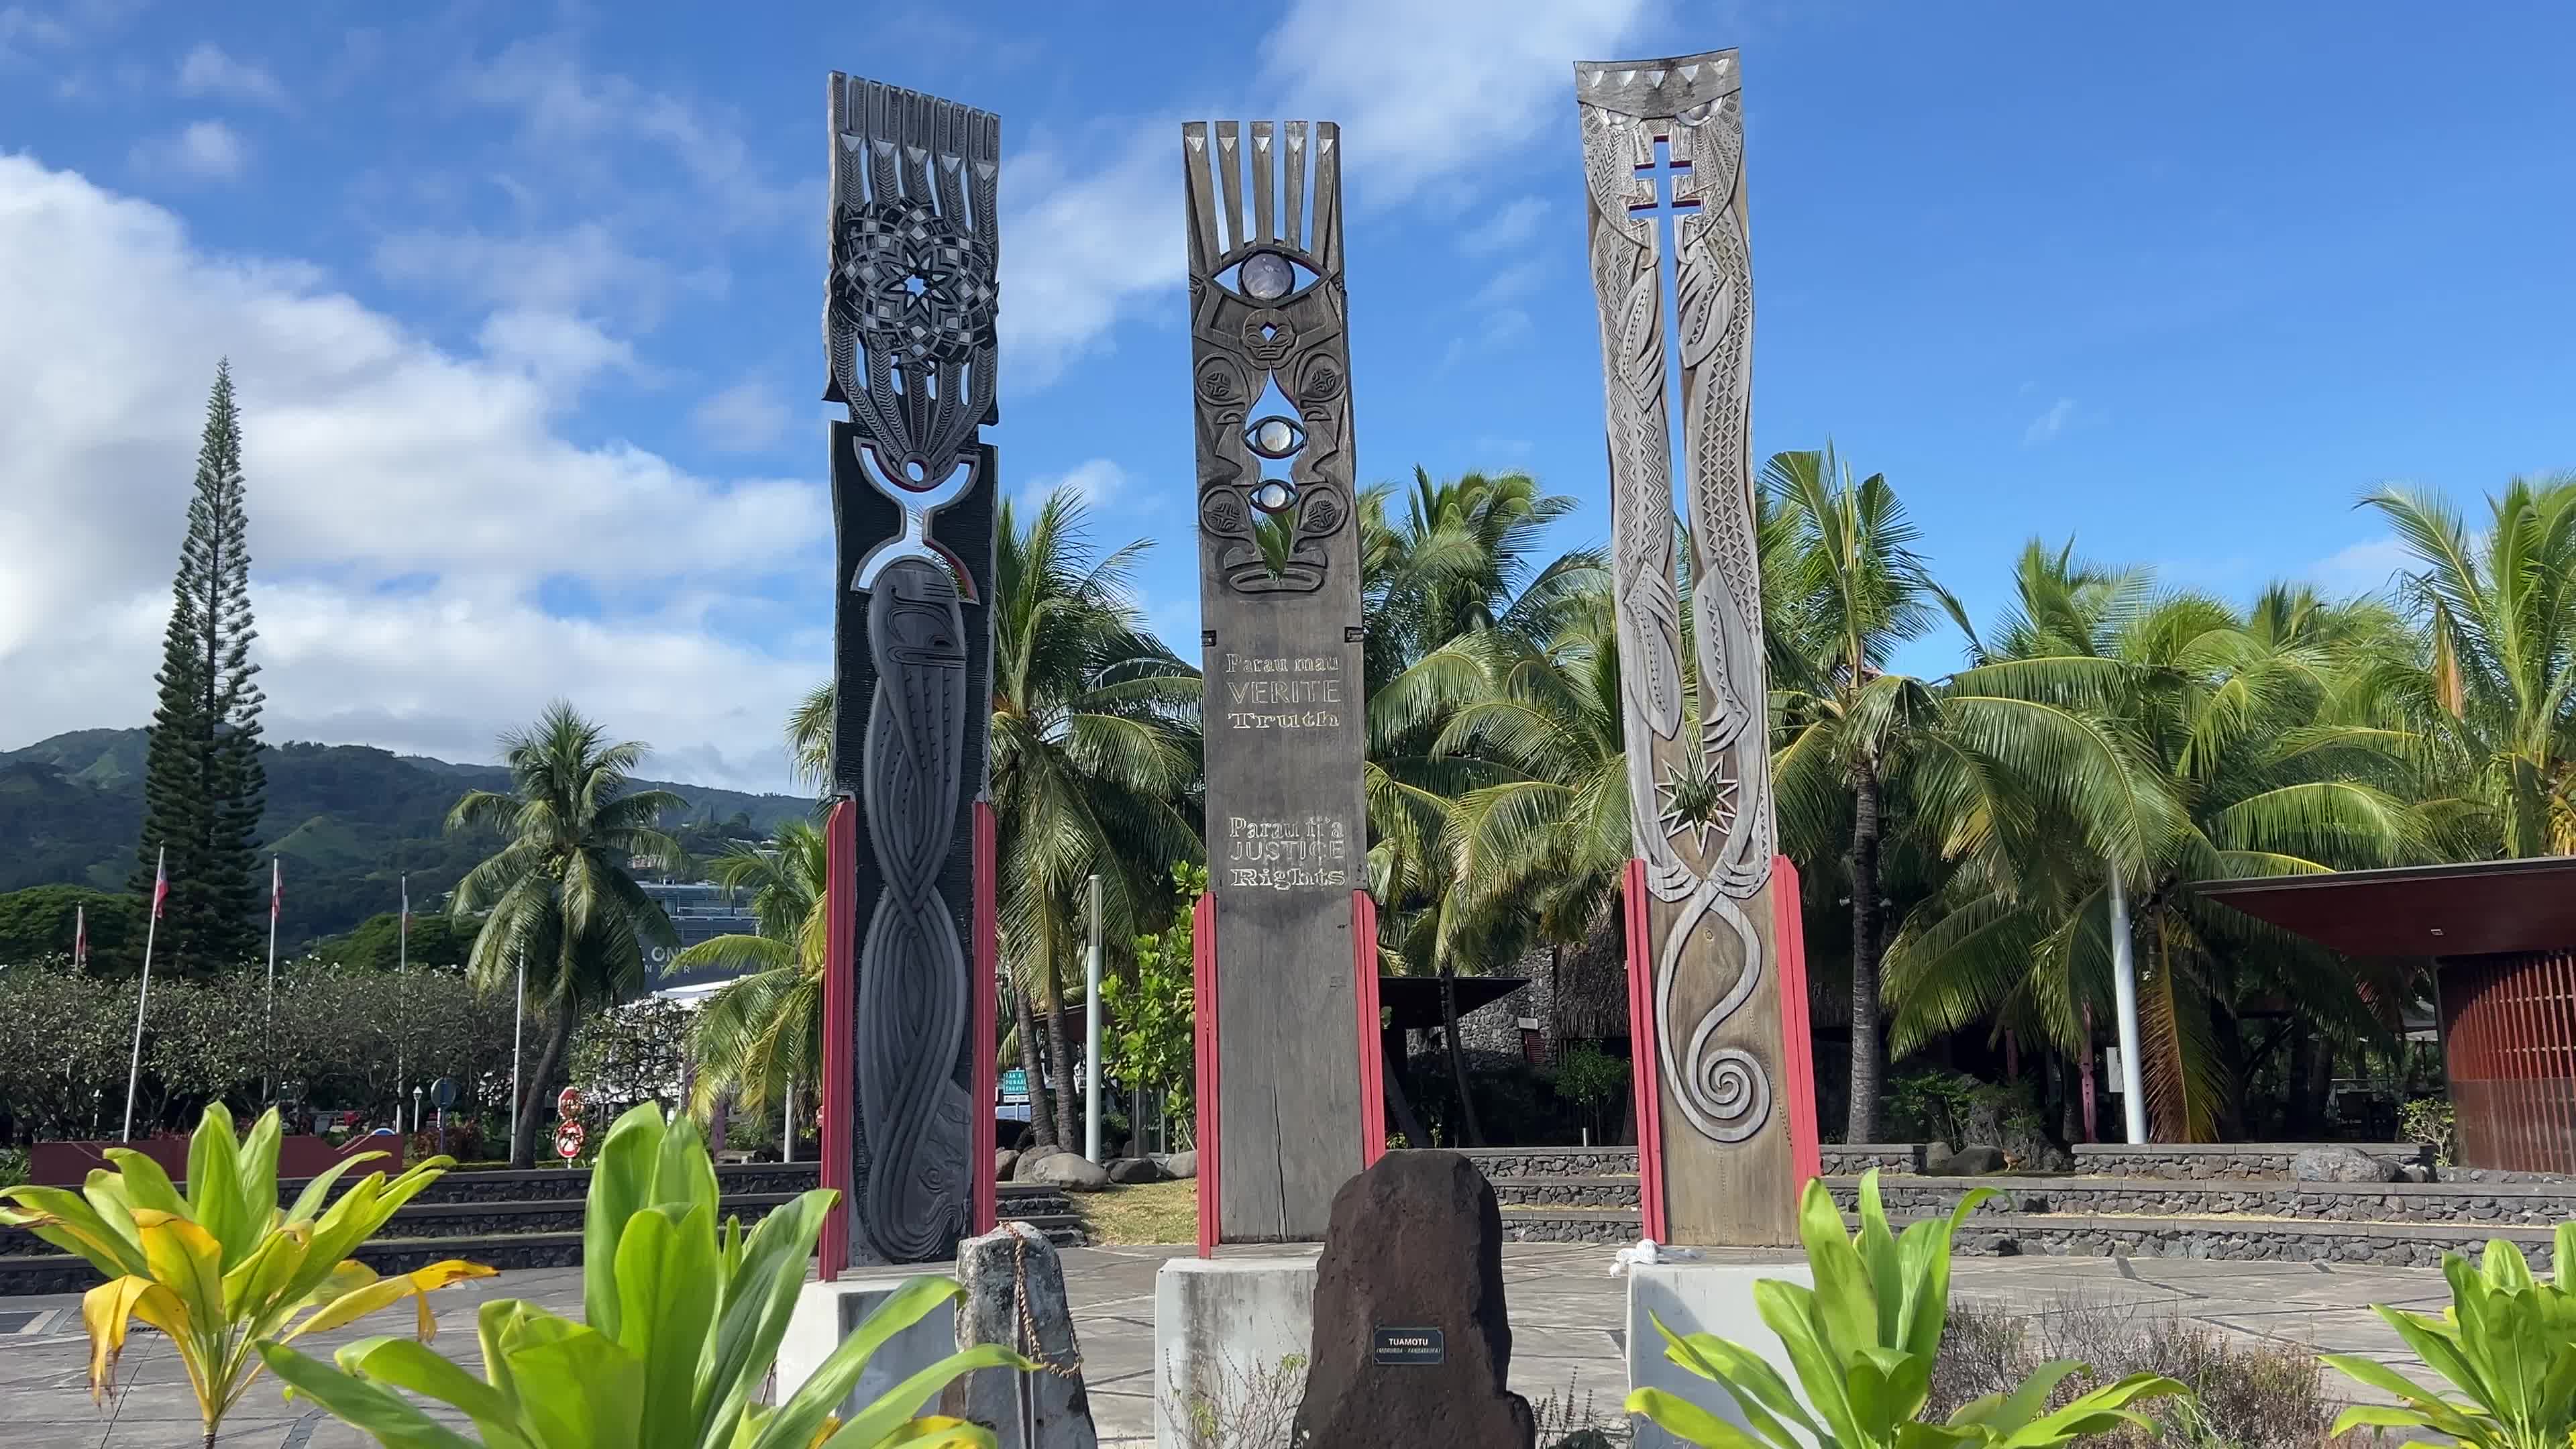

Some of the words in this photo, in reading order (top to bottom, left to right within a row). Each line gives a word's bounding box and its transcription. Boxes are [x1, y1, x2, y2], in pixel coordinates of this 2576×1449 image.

[1226, 653, 1288, 673] Parau
[1294, 657, 1339, 672] mau
[1226, 680, 1341, 704] VERITE
[1228, 710, 1340, 729] Truth
[1229, 816, 1299, 839] Parau
[1230, 841, 1344, 861] JUSTICE
[1230, 868, 1346, 891] Rights
[1389, 1338, 1428, 1346] TUAMOTU
